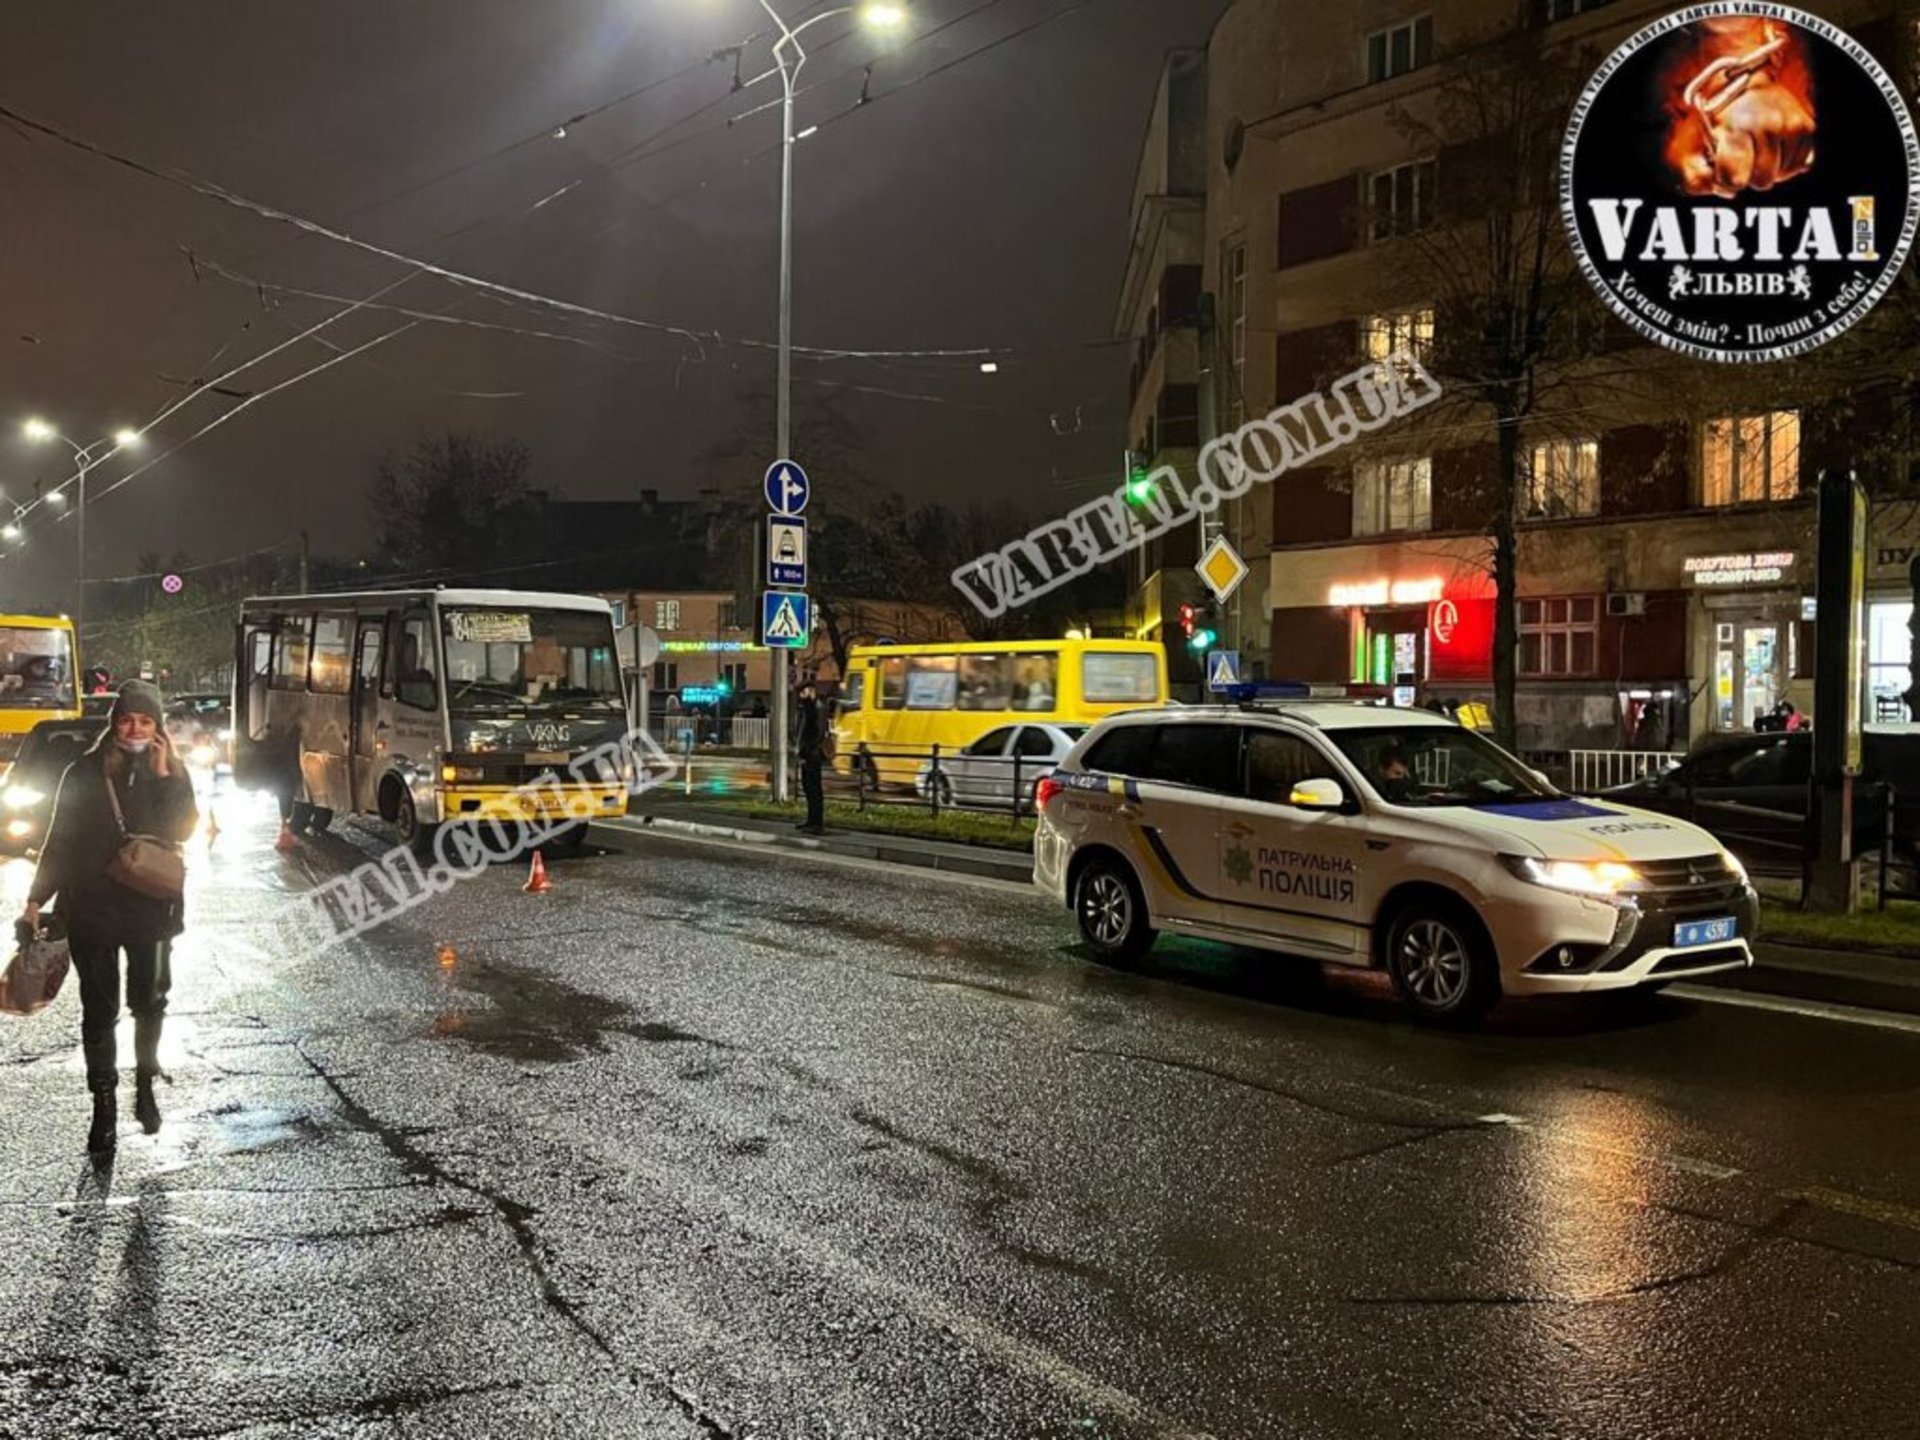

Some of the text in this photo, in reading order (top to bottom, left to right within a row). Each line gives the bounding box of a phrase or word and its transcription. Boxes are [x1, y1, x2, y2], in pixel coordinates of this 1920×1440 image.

[526, 724, 569, 742] VIKING
[1258, 848, 1354, 873] ПАТРУЛЬНА
[1259, 869, 1354, 903] ПОЛІЦІЯ
